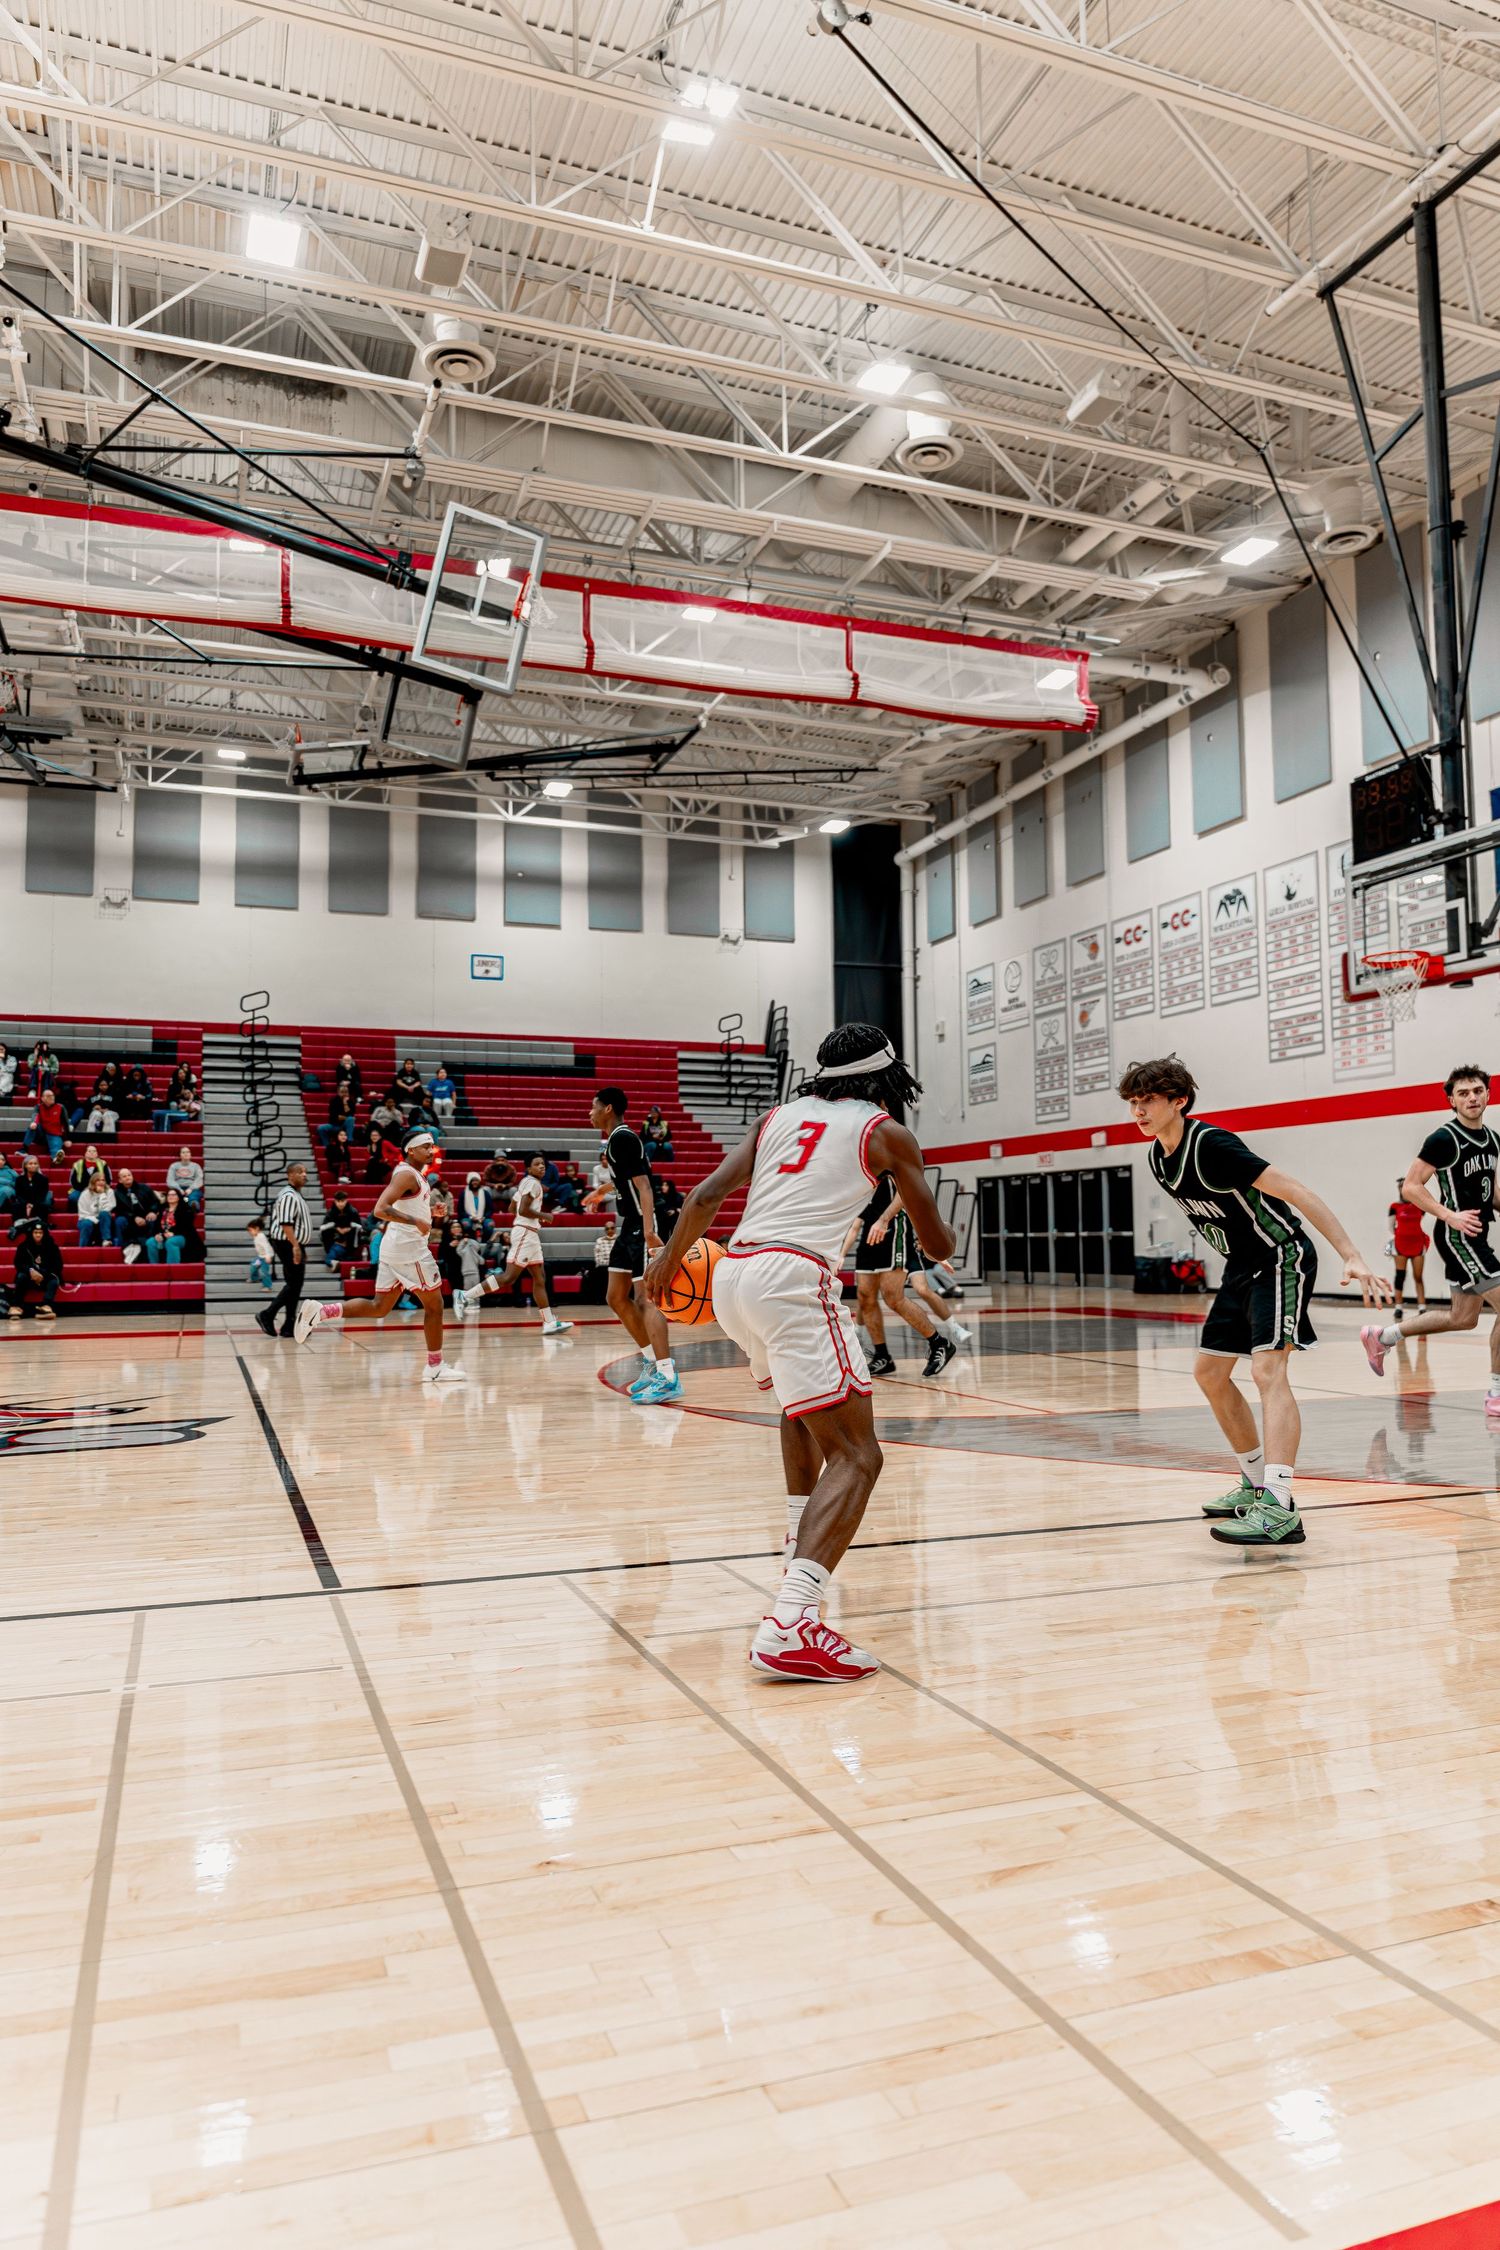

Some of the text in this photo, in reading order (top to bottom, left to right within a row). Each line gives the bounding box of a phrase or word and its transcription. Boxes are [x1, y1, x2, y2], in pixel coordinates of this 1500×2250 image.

[777, 1120, 829, 1175] 3
[1464, 1153, 1498, 1177] OAK LA
[1481, 1176, 1491, 1202] 3
[1283, 1314, 1295, 1336] S
